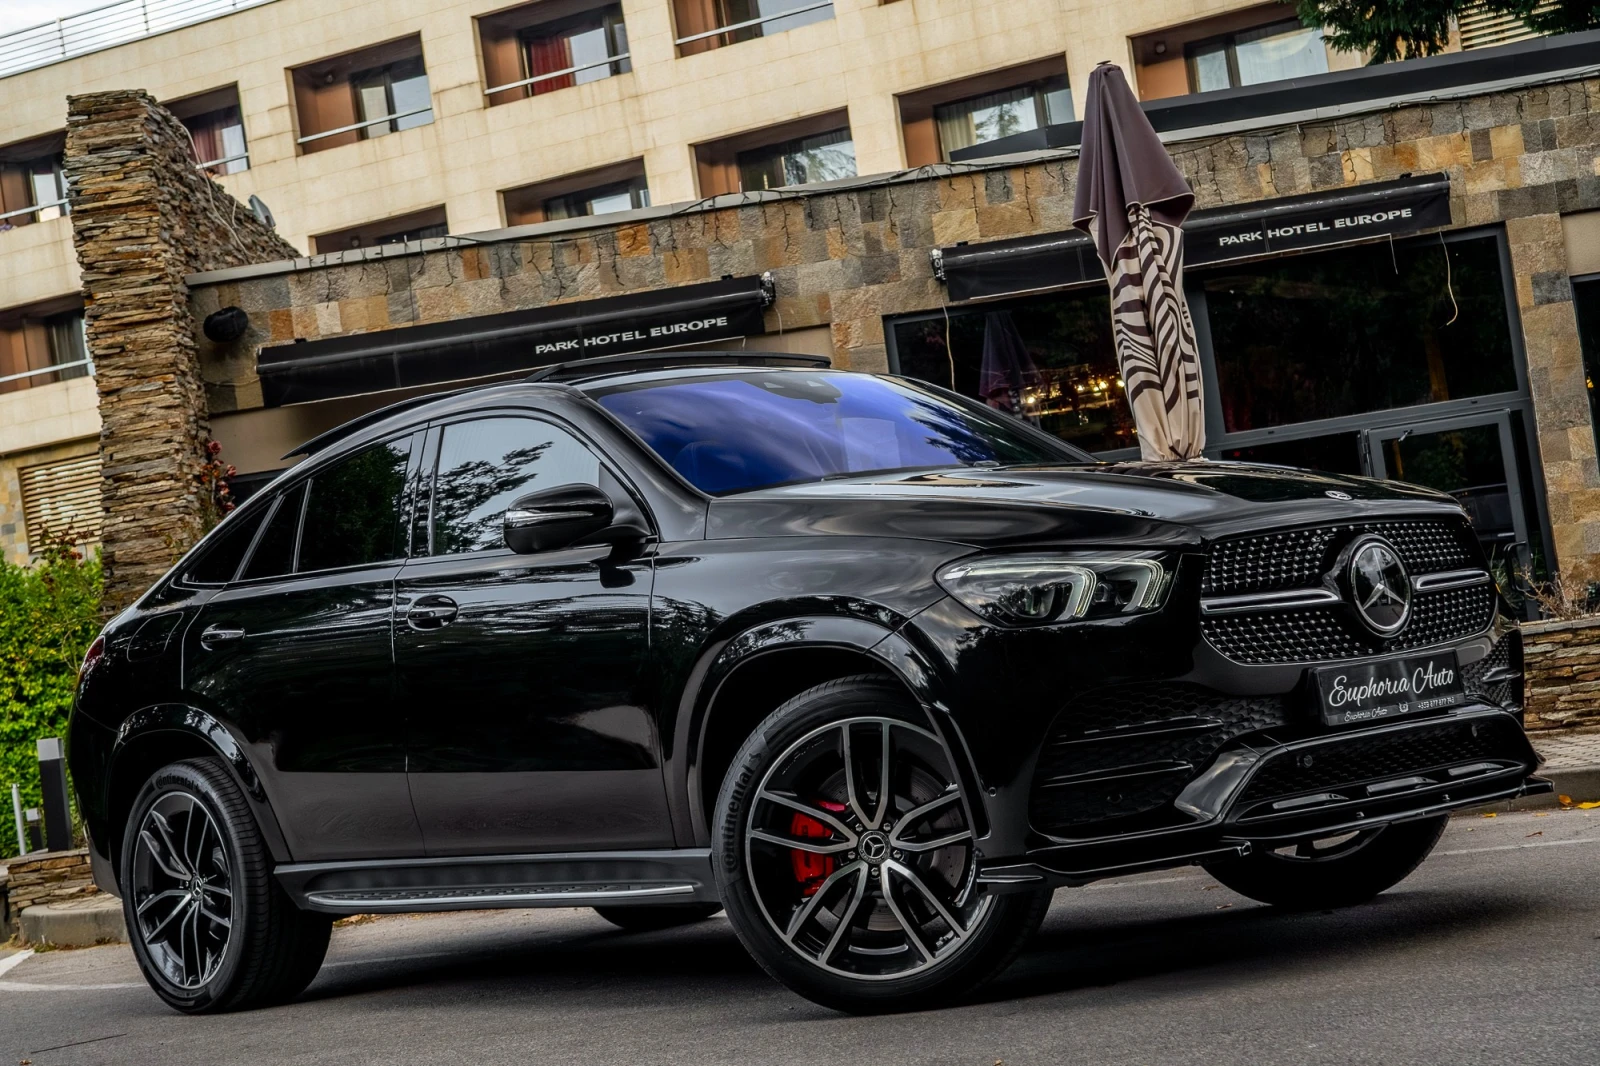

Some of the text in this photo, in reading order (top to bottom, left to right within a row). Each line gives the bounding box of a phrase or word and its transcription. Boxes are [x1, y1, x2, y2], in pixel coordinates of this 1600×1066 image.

[1219, 208, 1413, 246] PARK HOTEL EUROPE
[535, 316, 728, 354] PARK HOTEL EUROPE
[1329, 660, 1454, 707] Euphoria Auto
[155, 774, 194, 789] Continental
[720, 764, 754, 873] Continental
